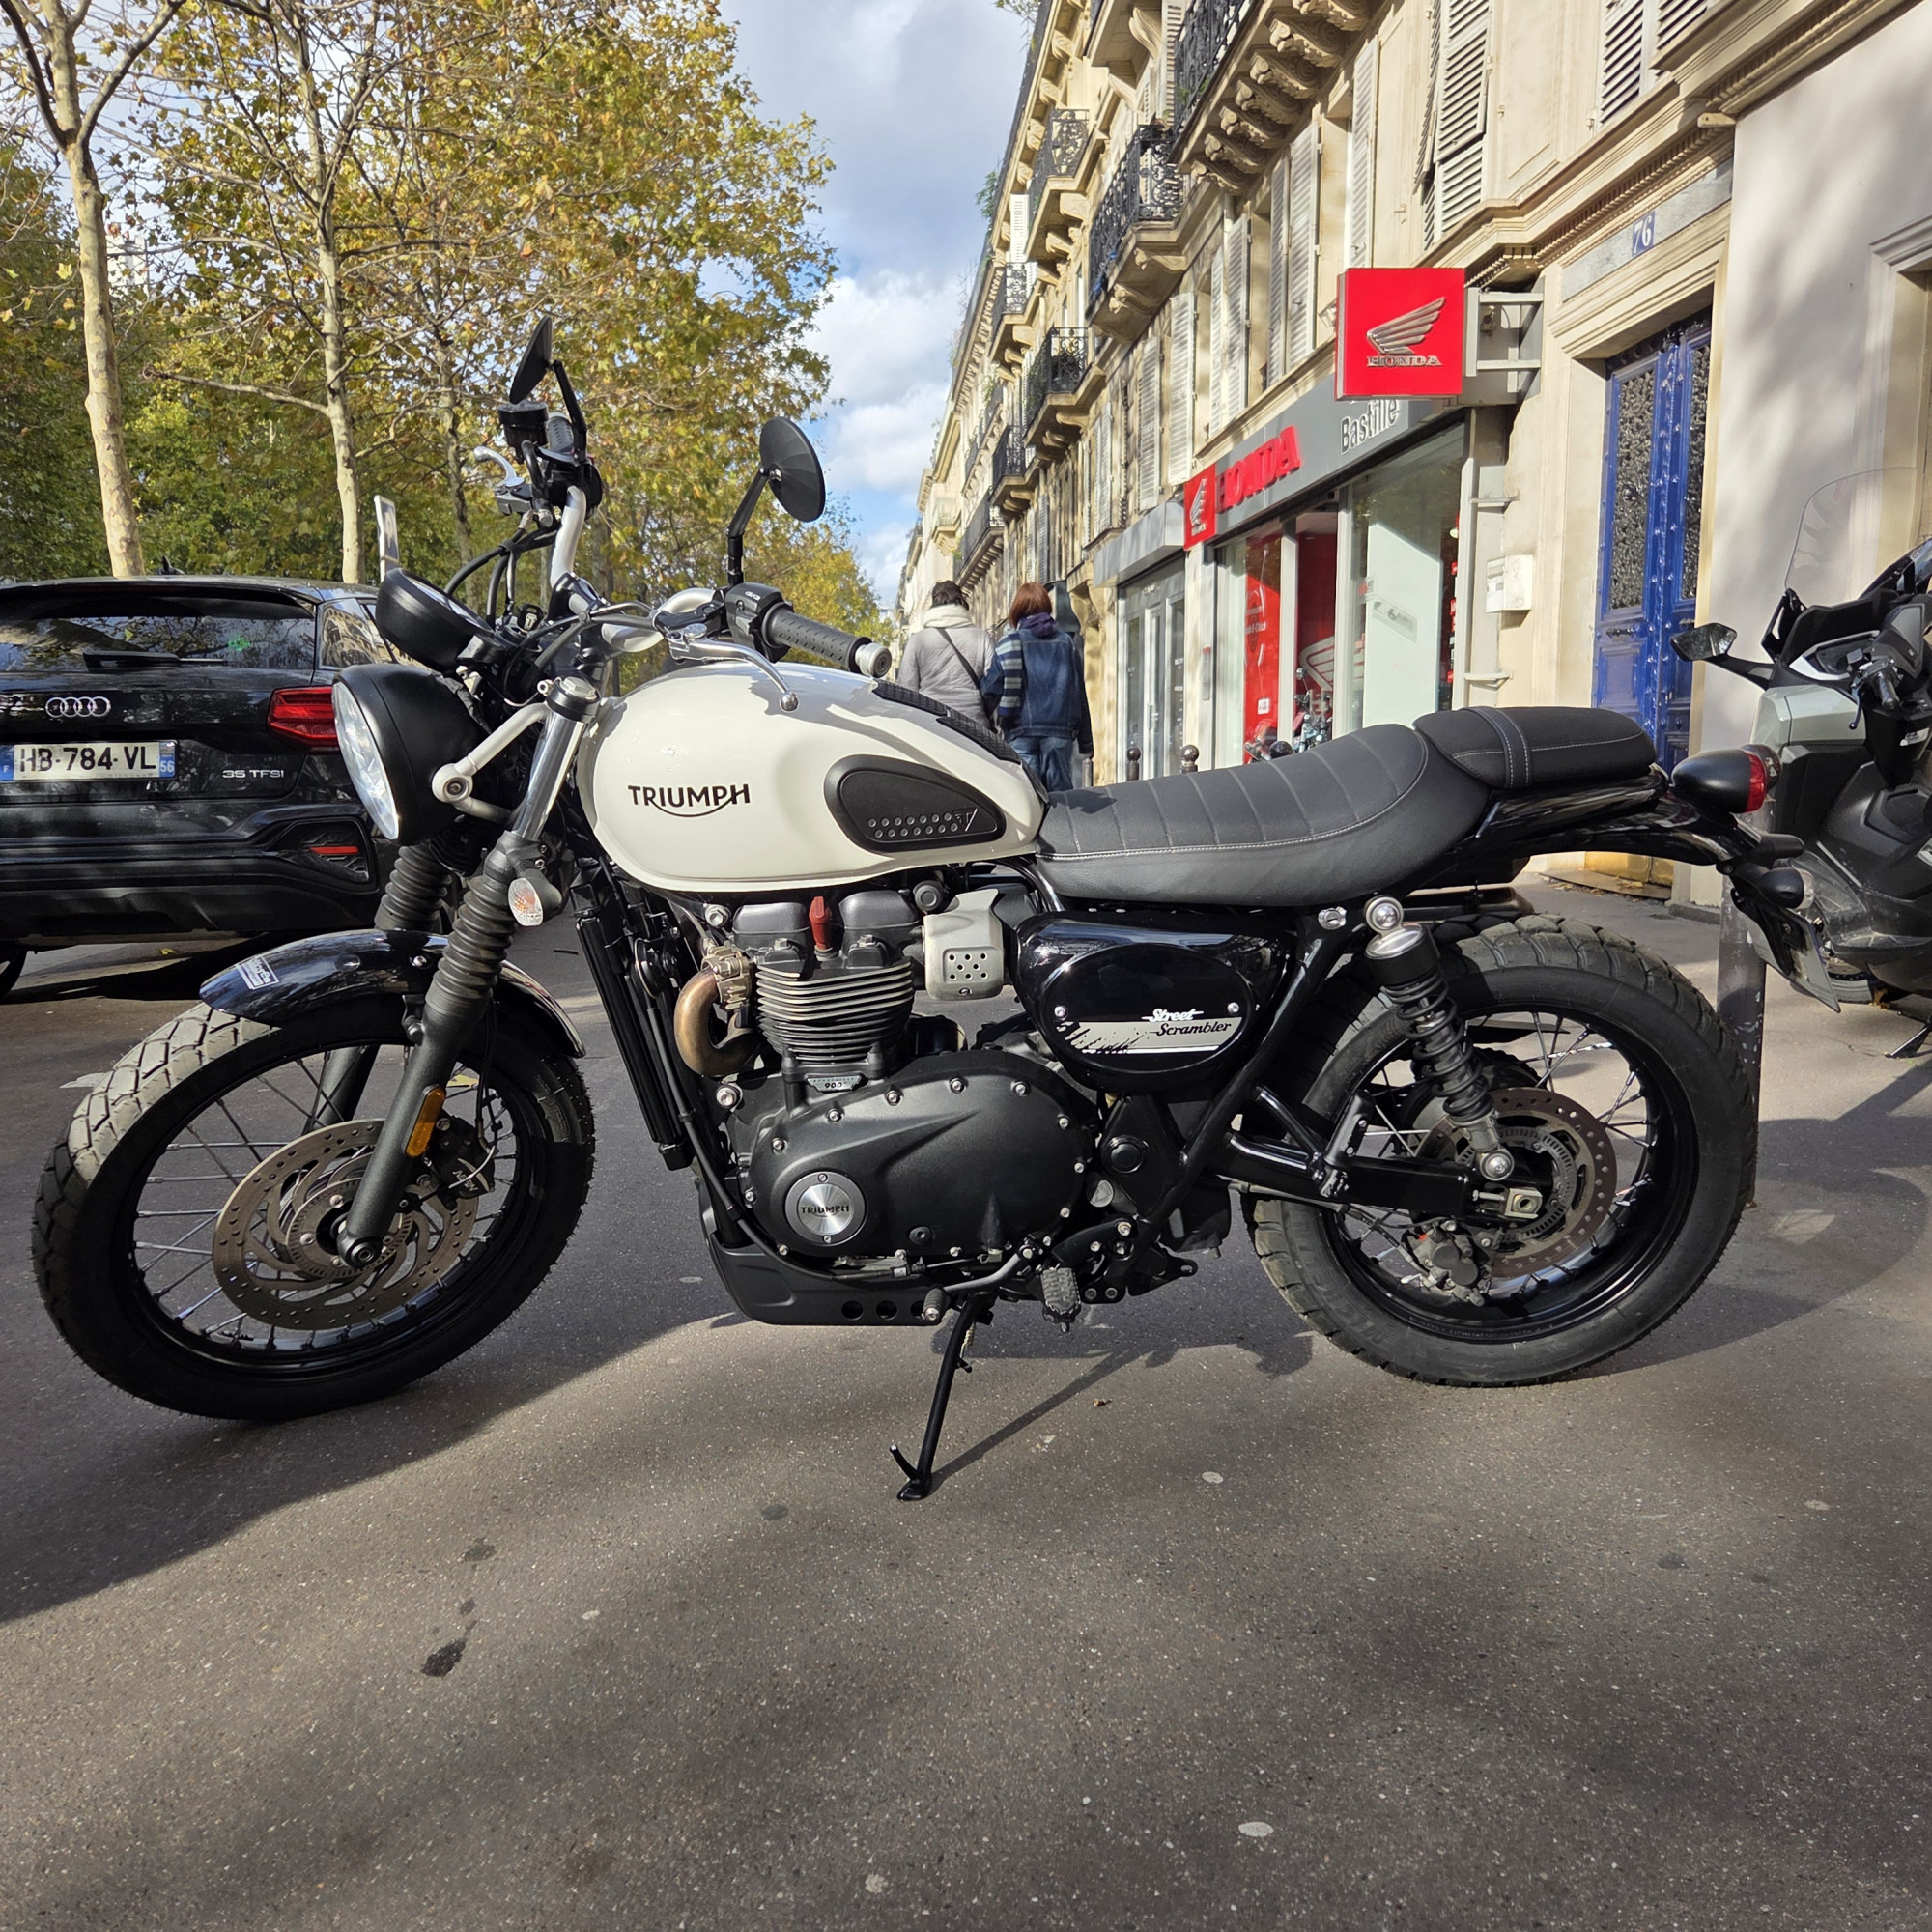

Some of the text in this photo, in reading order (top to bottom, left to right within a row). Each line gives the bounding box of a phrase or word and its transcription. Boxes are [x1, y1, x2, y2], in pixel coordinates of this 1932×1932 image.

[1634, 214, 1653, 254] 76
[1366, 355, 1443, 367] HONDA
[1340, 399, 1400, 455] Bastille
[1215, 425, 1301, 515] HONDA
[159, 760, 175, 773] 56
[222, 769, 284, 779] 35 TFSI
[627, 783, 751, 817] TRIUMPH
[1145, 1009, 1202, 1022] Street
[1151, 1022, 1232, 1037] Scrambler
[800, 1206, 850, 1218] TRIUMPH
